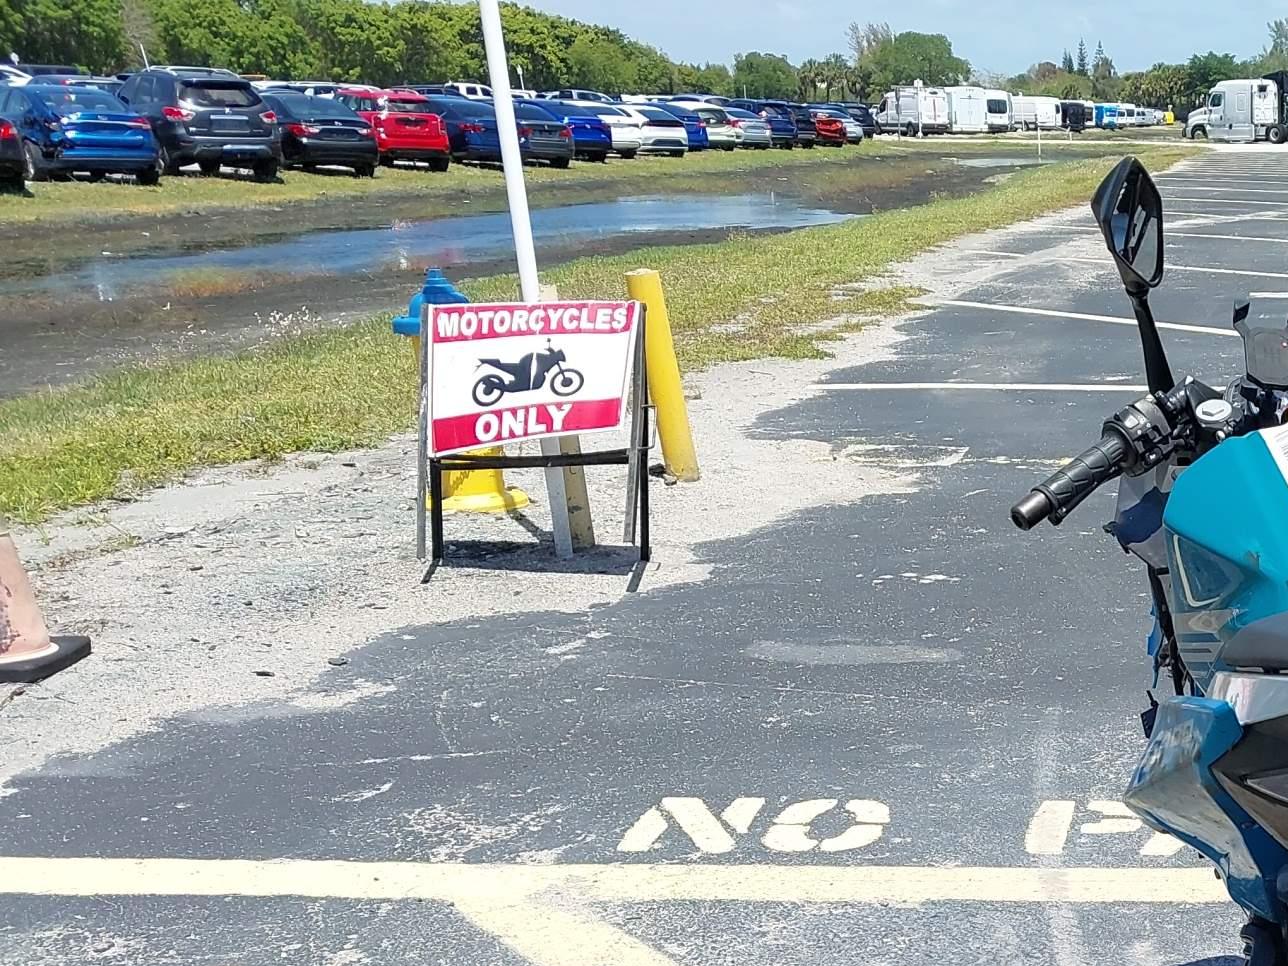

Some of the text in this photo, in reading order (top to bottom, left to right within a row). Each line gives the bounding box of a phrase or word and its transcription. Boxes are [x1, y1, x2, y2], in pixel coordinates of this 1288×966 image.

[437, 307, 628, 337] MOTORCYCLES
[474, 403, 575, 442] ONLY
[615, 797, 891, 854] NO
